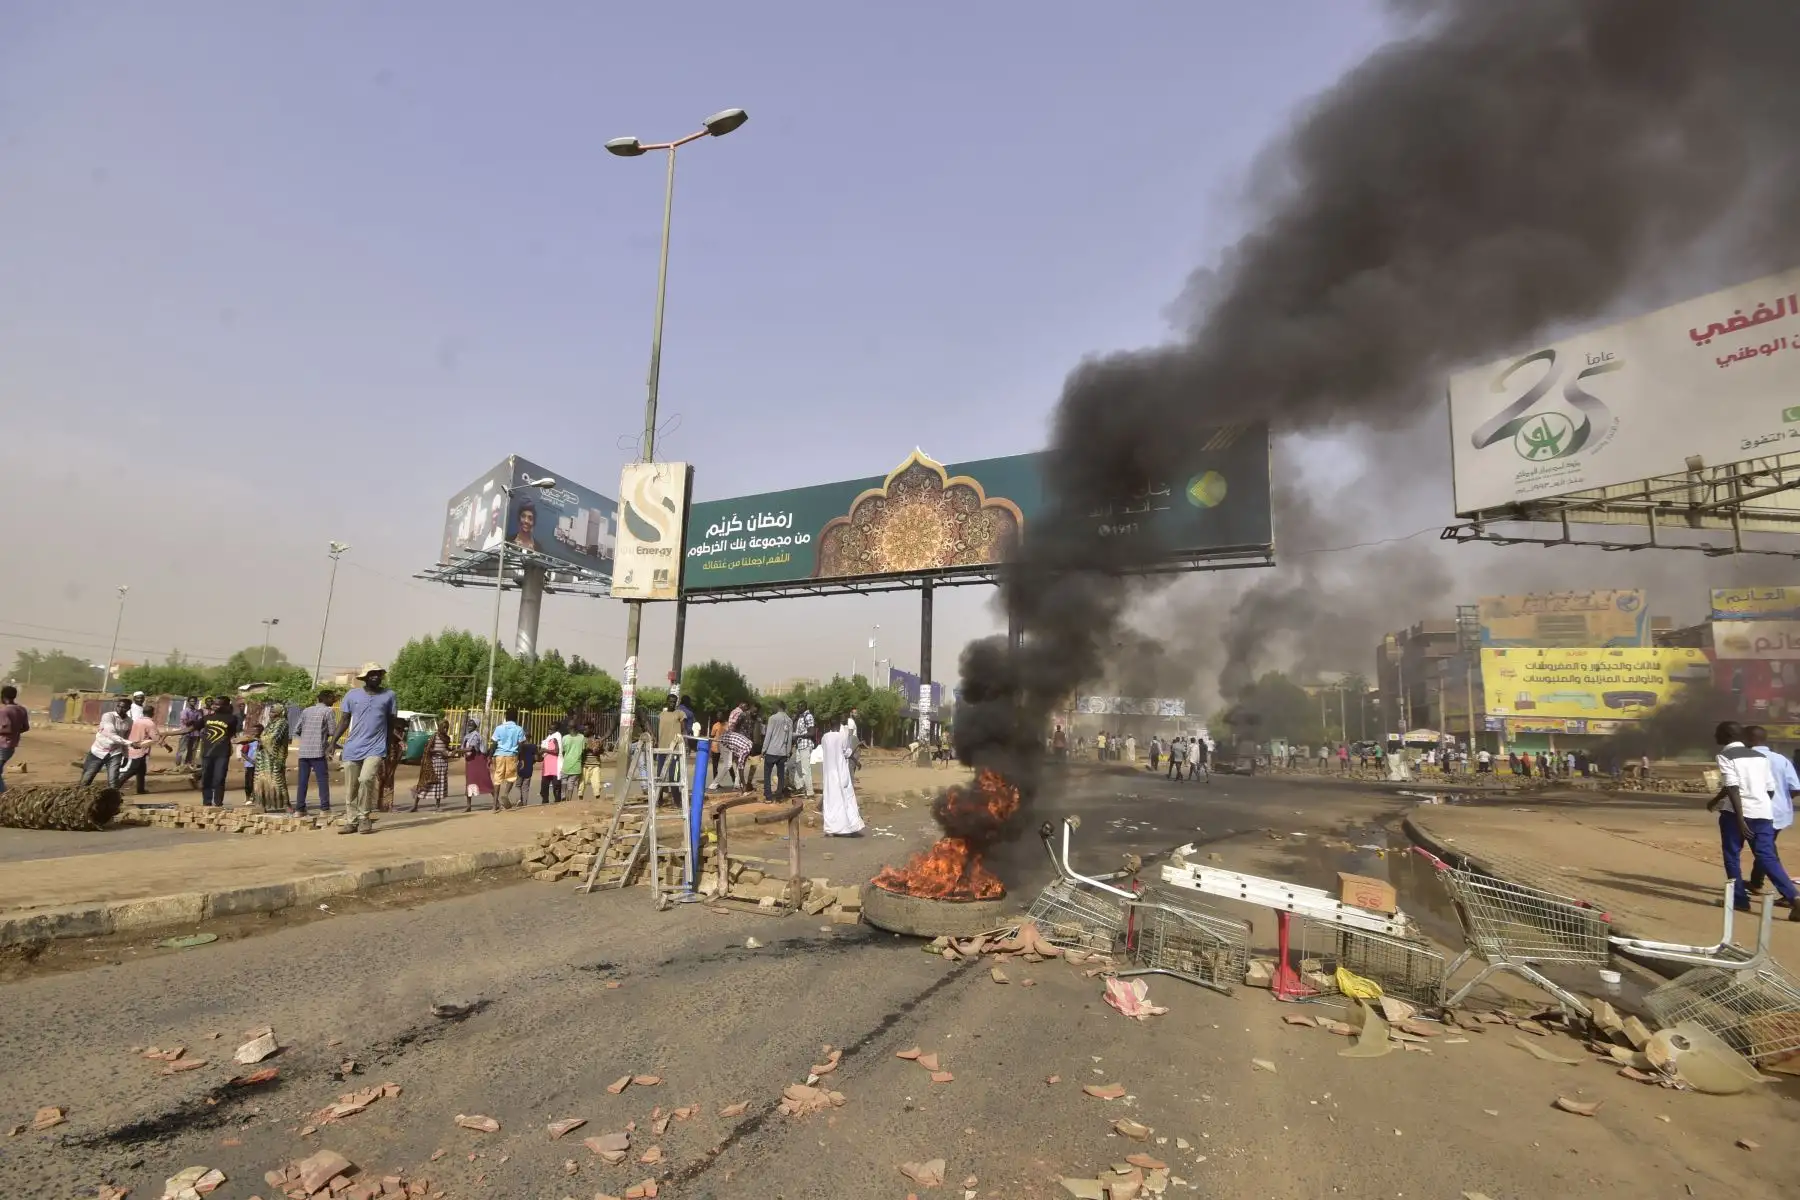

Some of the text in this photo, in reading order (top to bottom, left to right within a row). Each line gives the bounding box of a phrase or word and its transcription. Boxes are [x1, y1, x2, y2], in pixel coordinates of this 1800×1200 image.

[1689, 293, 1798, 347] الفضي
[1716, 337, 1787, 368] الوطني
[636, 546, 672, 556] Energy
[687, 532, 811, 557] من مجموعة بنك الخرطوم
